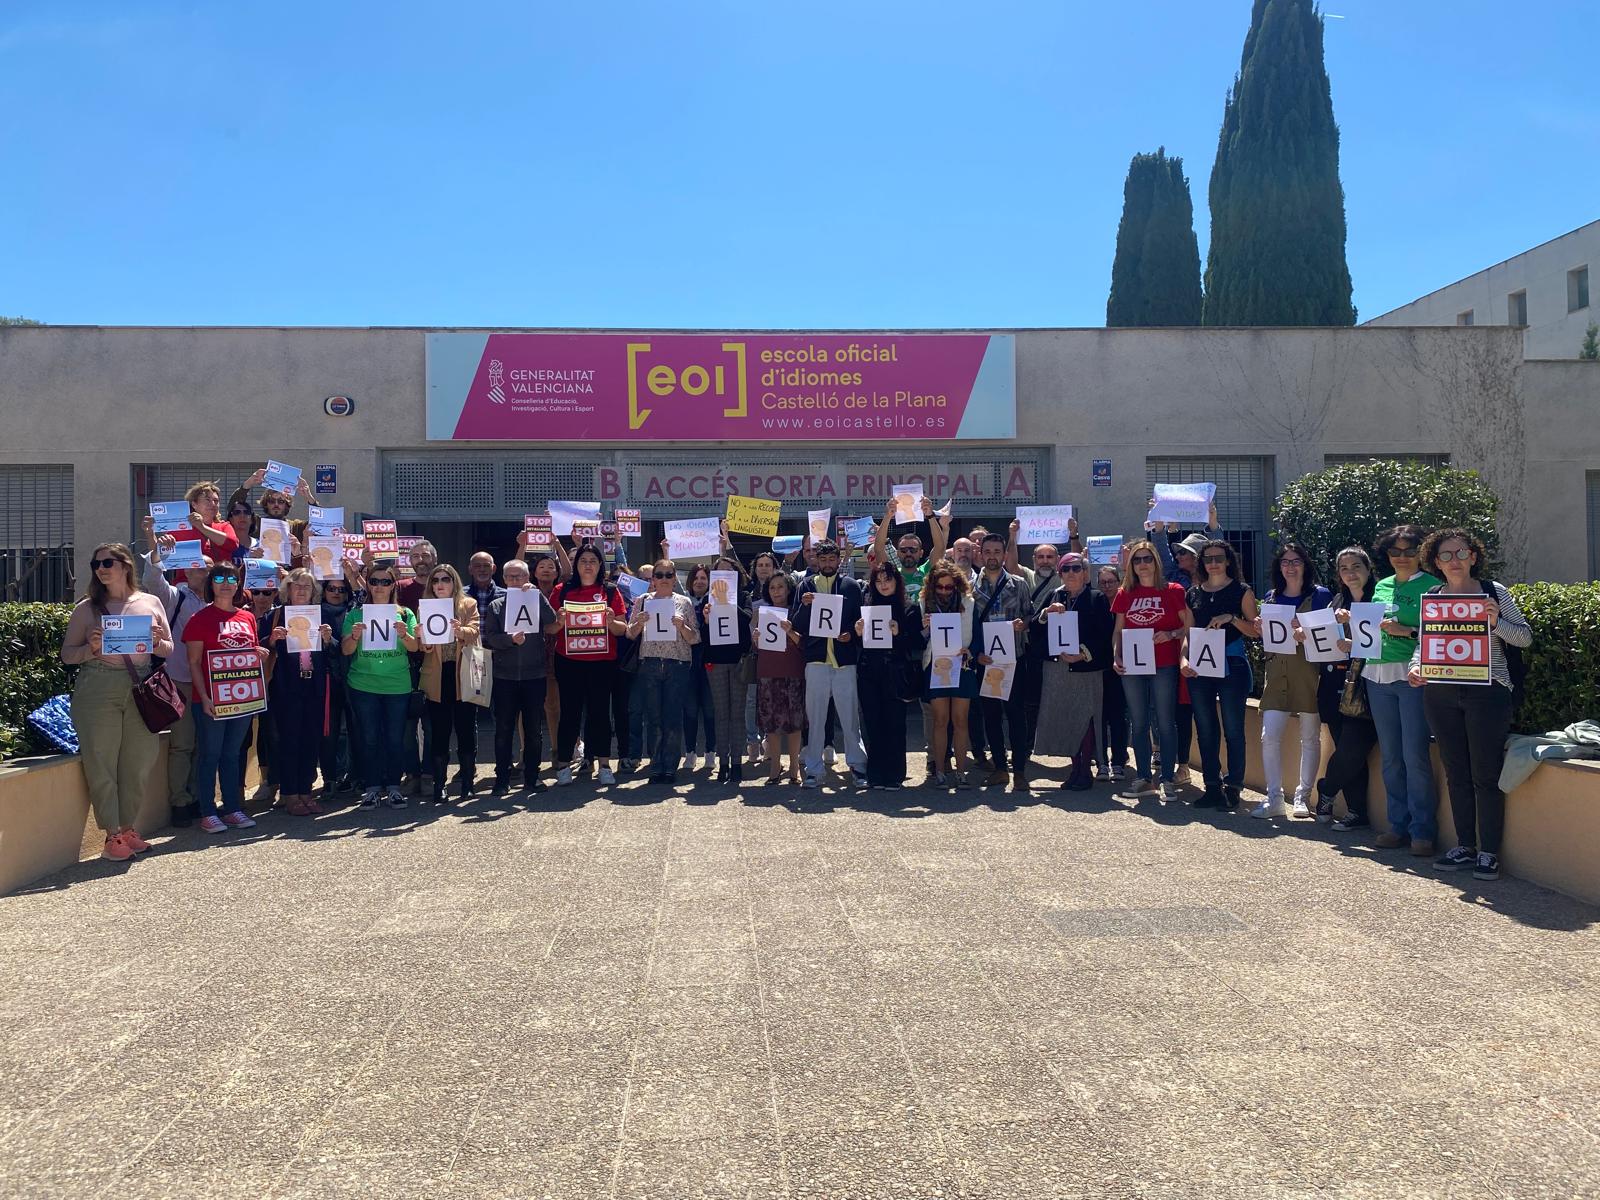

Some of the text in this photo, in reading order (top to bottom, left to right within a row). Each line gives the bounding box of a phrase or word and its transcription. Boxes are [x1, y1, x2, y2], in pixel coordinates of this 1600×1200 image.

[760, 344, 898, 363] escola oficial
[510, 369, 596, 381] GENERALITAT
[761, 368, 863, 387] d'idiomes
[511, 382, 594, 394] VALENCIANA
[511, 397, 544, 405] Conselleria
[511, 405, 549, 413] Investigació,
[575, 405, 595, 413] Esport
[761, 391, 947, 410] Castelló de la Plana
[761, 414, 946, 430] www.eoicastello.es
[600, 468, 621, 499] B
[644, 468, 740, 499] ACCÉS
[750, 474, 837, 498] PORTA
[1004, 467, 1033, 497] A
[731, 498, 741, 507] NO
[366, 523, 394, 532] STOP
[527, 517, 551, 526] STOP
[618, 522, 639, 532] EOI
[369, 540, 394, 551] EOI
[527, 533, 551, 544] EOI
[1130, 596, 1162, 611] UGT
[1425, 602, 1484, 618] STOP
[426, 613, 448, 636] O
[514, 604, 533, 627] A
[570, 613, 603, 626] EOI
[656, 612, 668, 633] L
[818, 608, 833, 630] R
[219, 621, 251, 635] UGT
[370, 619, 390, 642] N
[718, 617, 731, 637] E
[765, 622, 778, 643] S
[871, 619, 884, 641] E
[1058, 625, 1070, 647] L
[1269, 620, 1287, 645] D
[1359, 619, 1373, 649] S
[1425, 624, 1485, 632] RETALLADES
[568, 637, 605, 649] STOP
[938, 626, 954, 648] T
[989, 635, 1007, 656] A
[1311, 626, 1332, 653] E
[1133, 644, 1147, 667] L
[1196, 644, 1217, 669] A
[1428, 638, 1482, 662] EOI
[212, 654, 258, 669] STOP
[1424, 667, 1444, 675] UGT
[213, 670, 260, 680] RETALLADES
[217, 681, 260, 702] EOI
[217, 706, 233, 714] UGT
